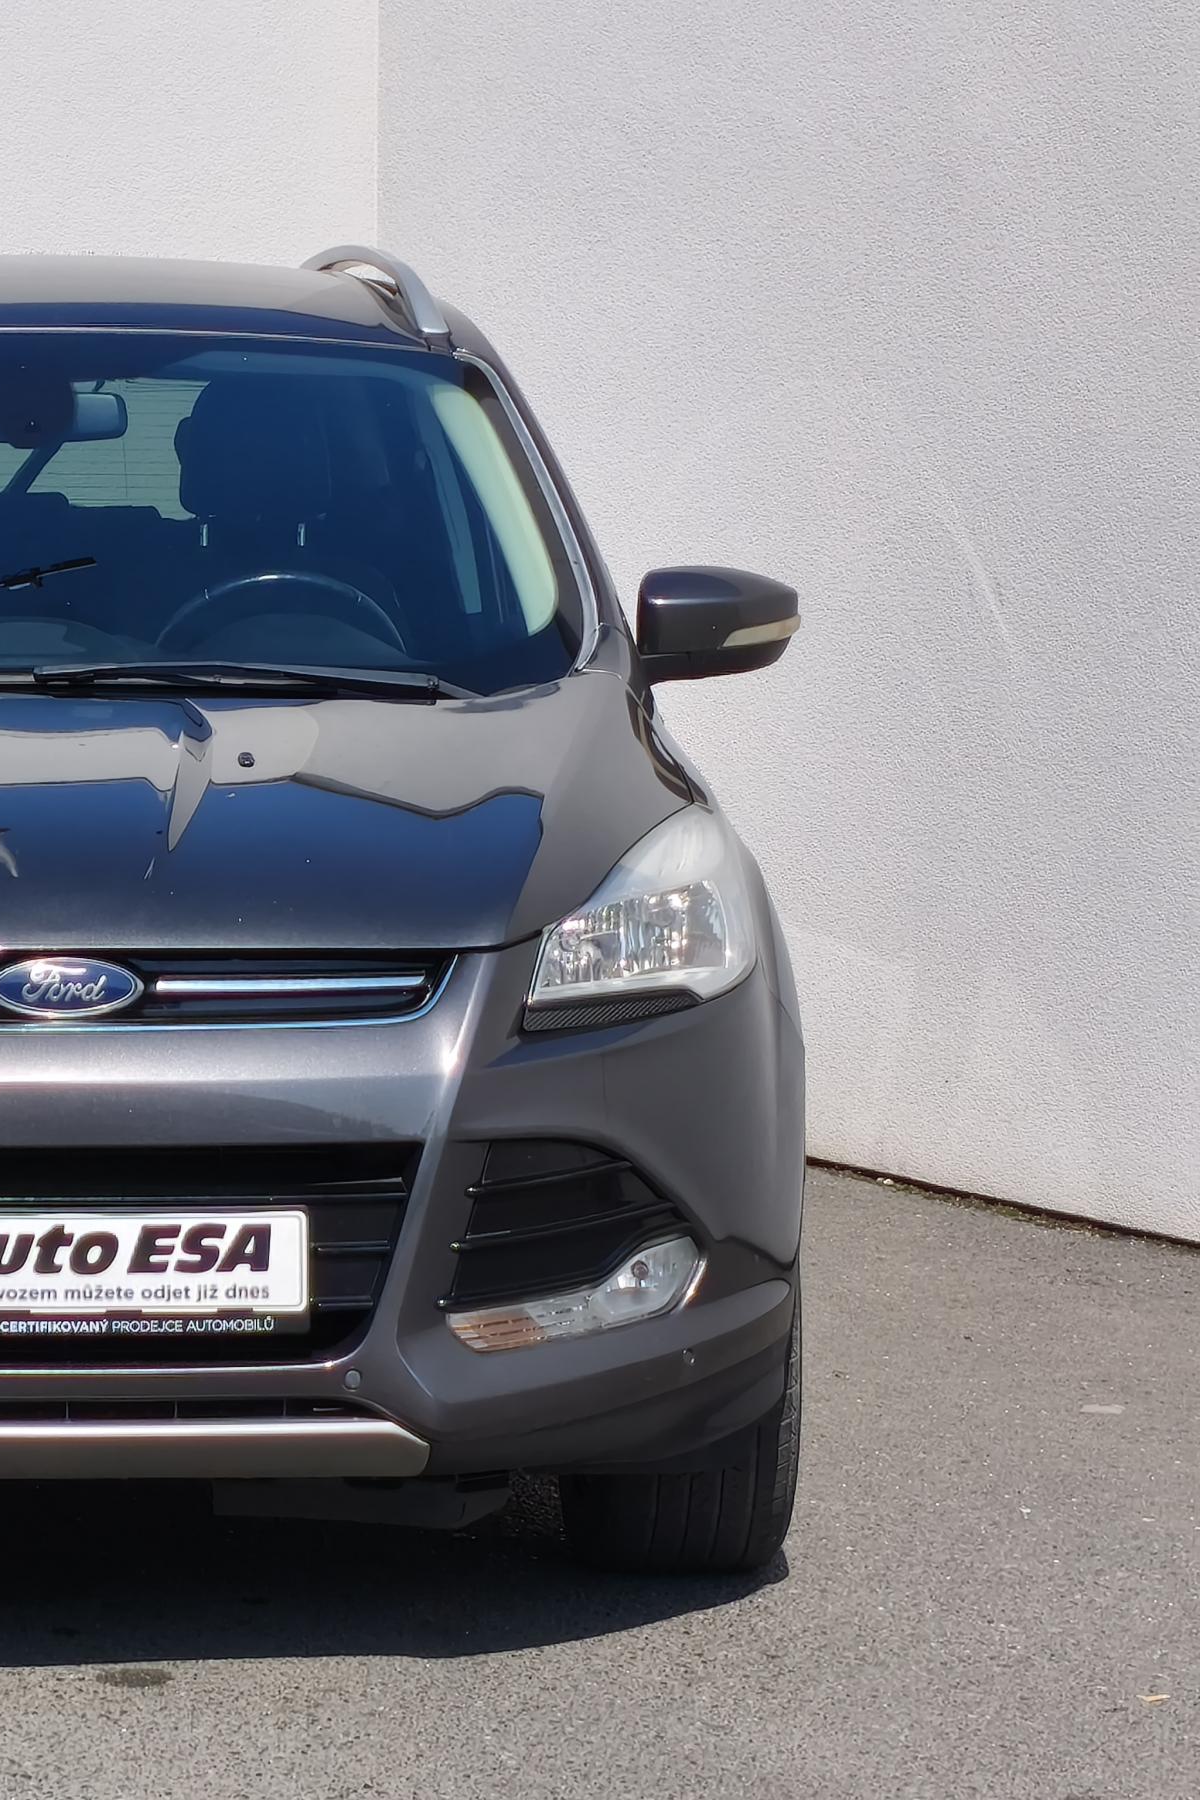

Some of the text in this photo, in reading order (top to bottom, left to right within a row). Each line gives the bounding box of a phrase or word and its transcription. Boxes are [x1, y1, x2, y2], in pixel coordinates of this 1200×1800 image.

[22, 962, 107, 1001] Ford
[126, 1222, 272, 1275] ESA
[65, 1284, 135, 1300] můžete
[141, 1284, 191, 1302] odjet
[196, 1284, 219, 1302] již
[224, 1284, 270, 1300] dnes
[0, 1318, 108, 1333] CERTIFIKOVANÝ
[111, 1319, 183, 1333] PRODEJCE
[186, 1315, 274, 1332] AUTOMOBILŮ
